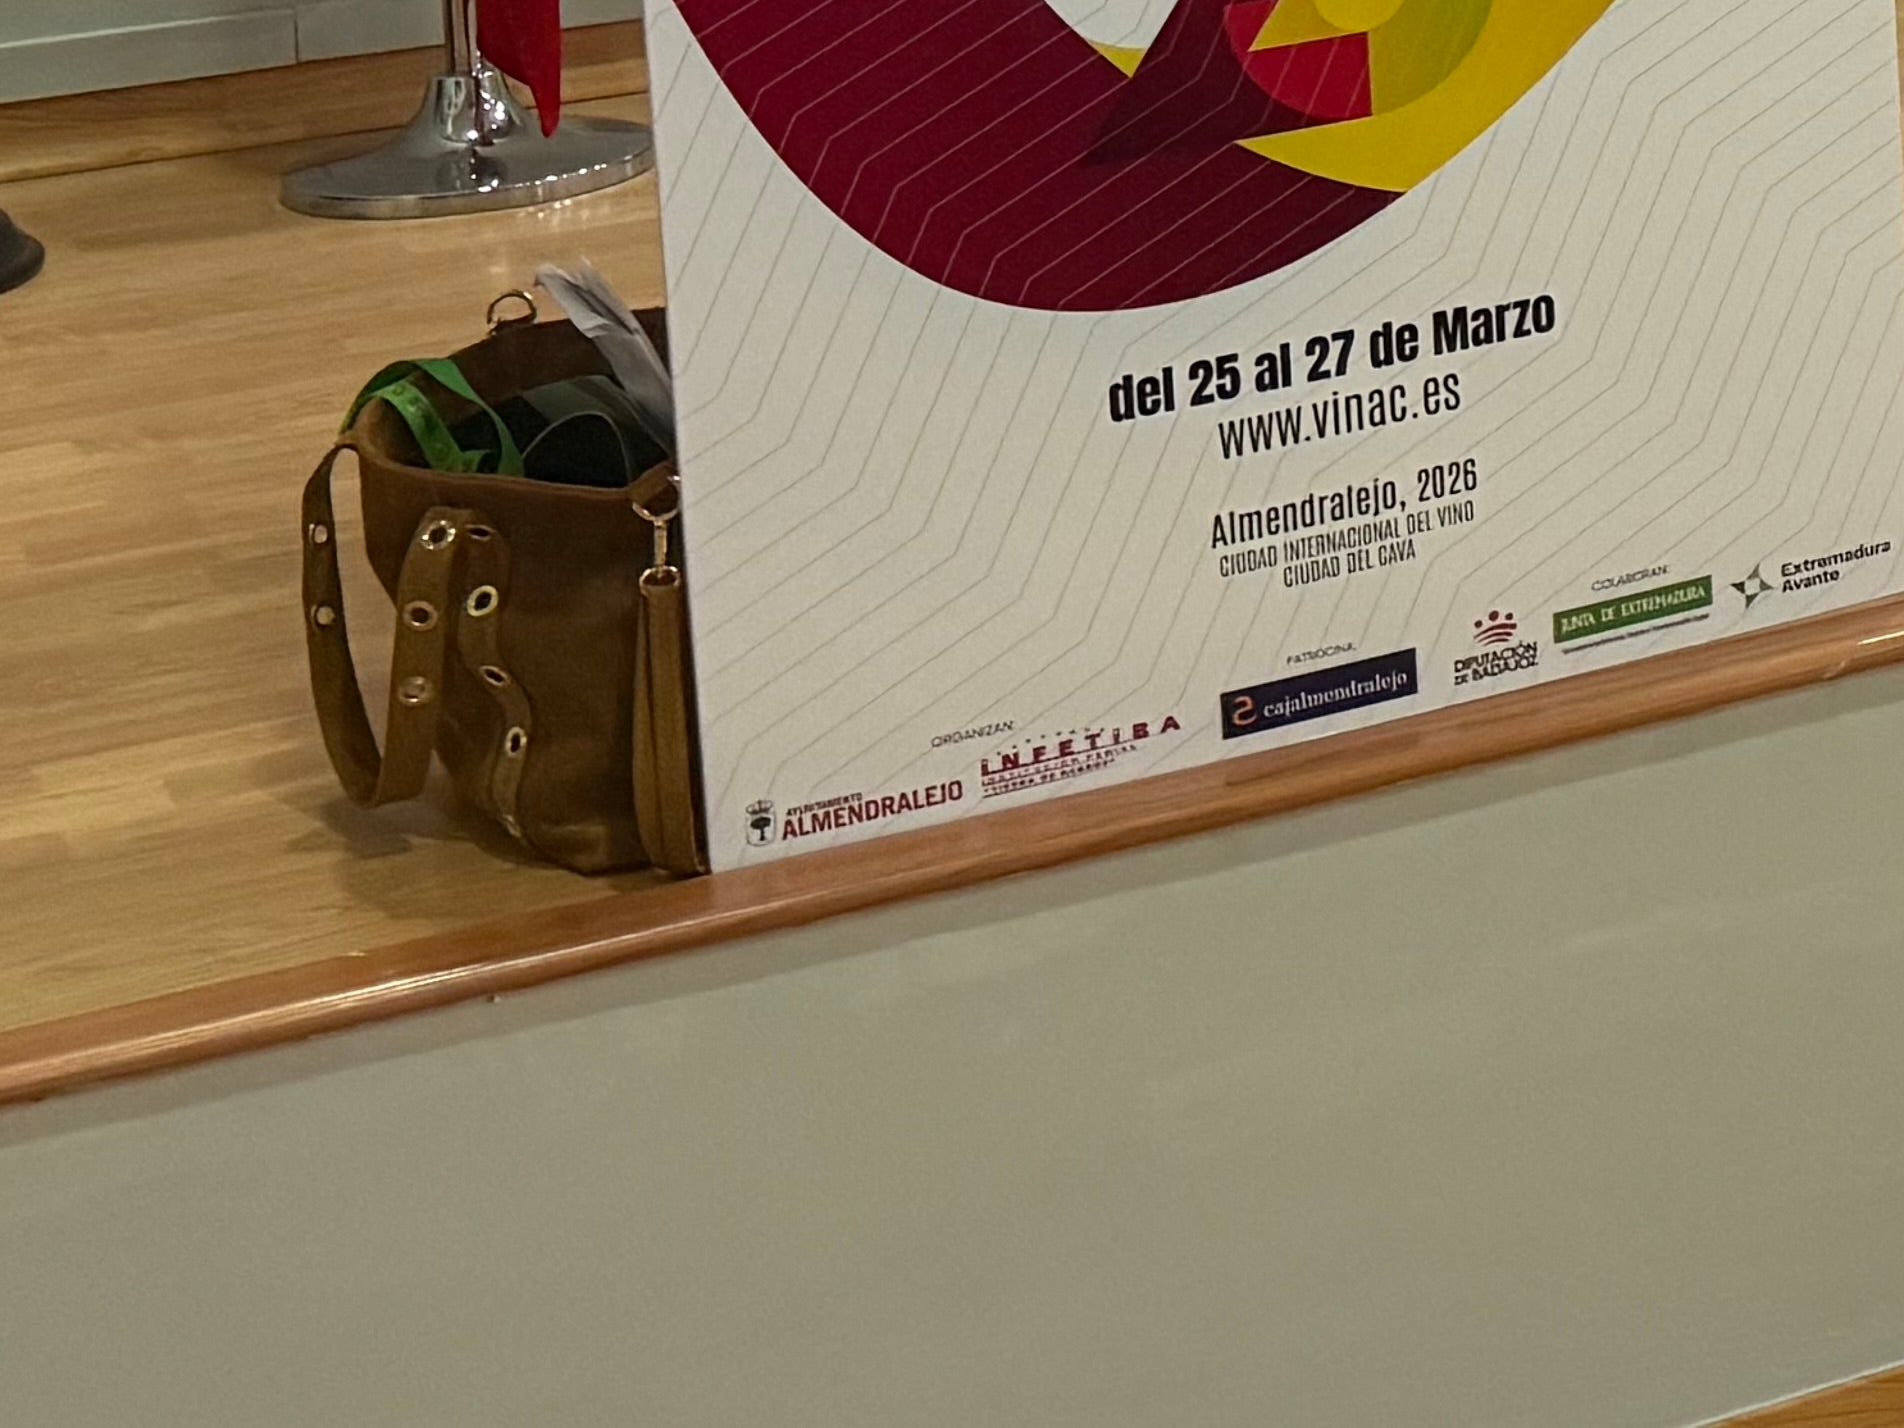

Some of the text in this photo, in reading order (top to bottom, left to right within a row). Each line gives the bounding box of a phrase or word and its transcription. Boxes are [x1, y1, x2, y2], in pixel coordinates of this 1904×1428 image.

[1108, 293, 1556, 423] del 25 al 27 de Marzo
[1218, 372, 1462, 460] www.vinac.es
[1211, 458, 1478, 549] Almendralejo, 2026
[1219, 500, 1475, 578] CIUDAD INTERNACIONAL DEL VINO
[1283, 538, 1417, 589] CIUDAD DEL CAVA
[1780, 540, 1891, 578] Extremadura
[1782, 568, 1840, 594] Avante
[1601, 606, 1617, 622] DE
[1263, 671, 1409, 718] cajalmendralejo
[781, 779, 964, 841] ALMENDRALEJO
